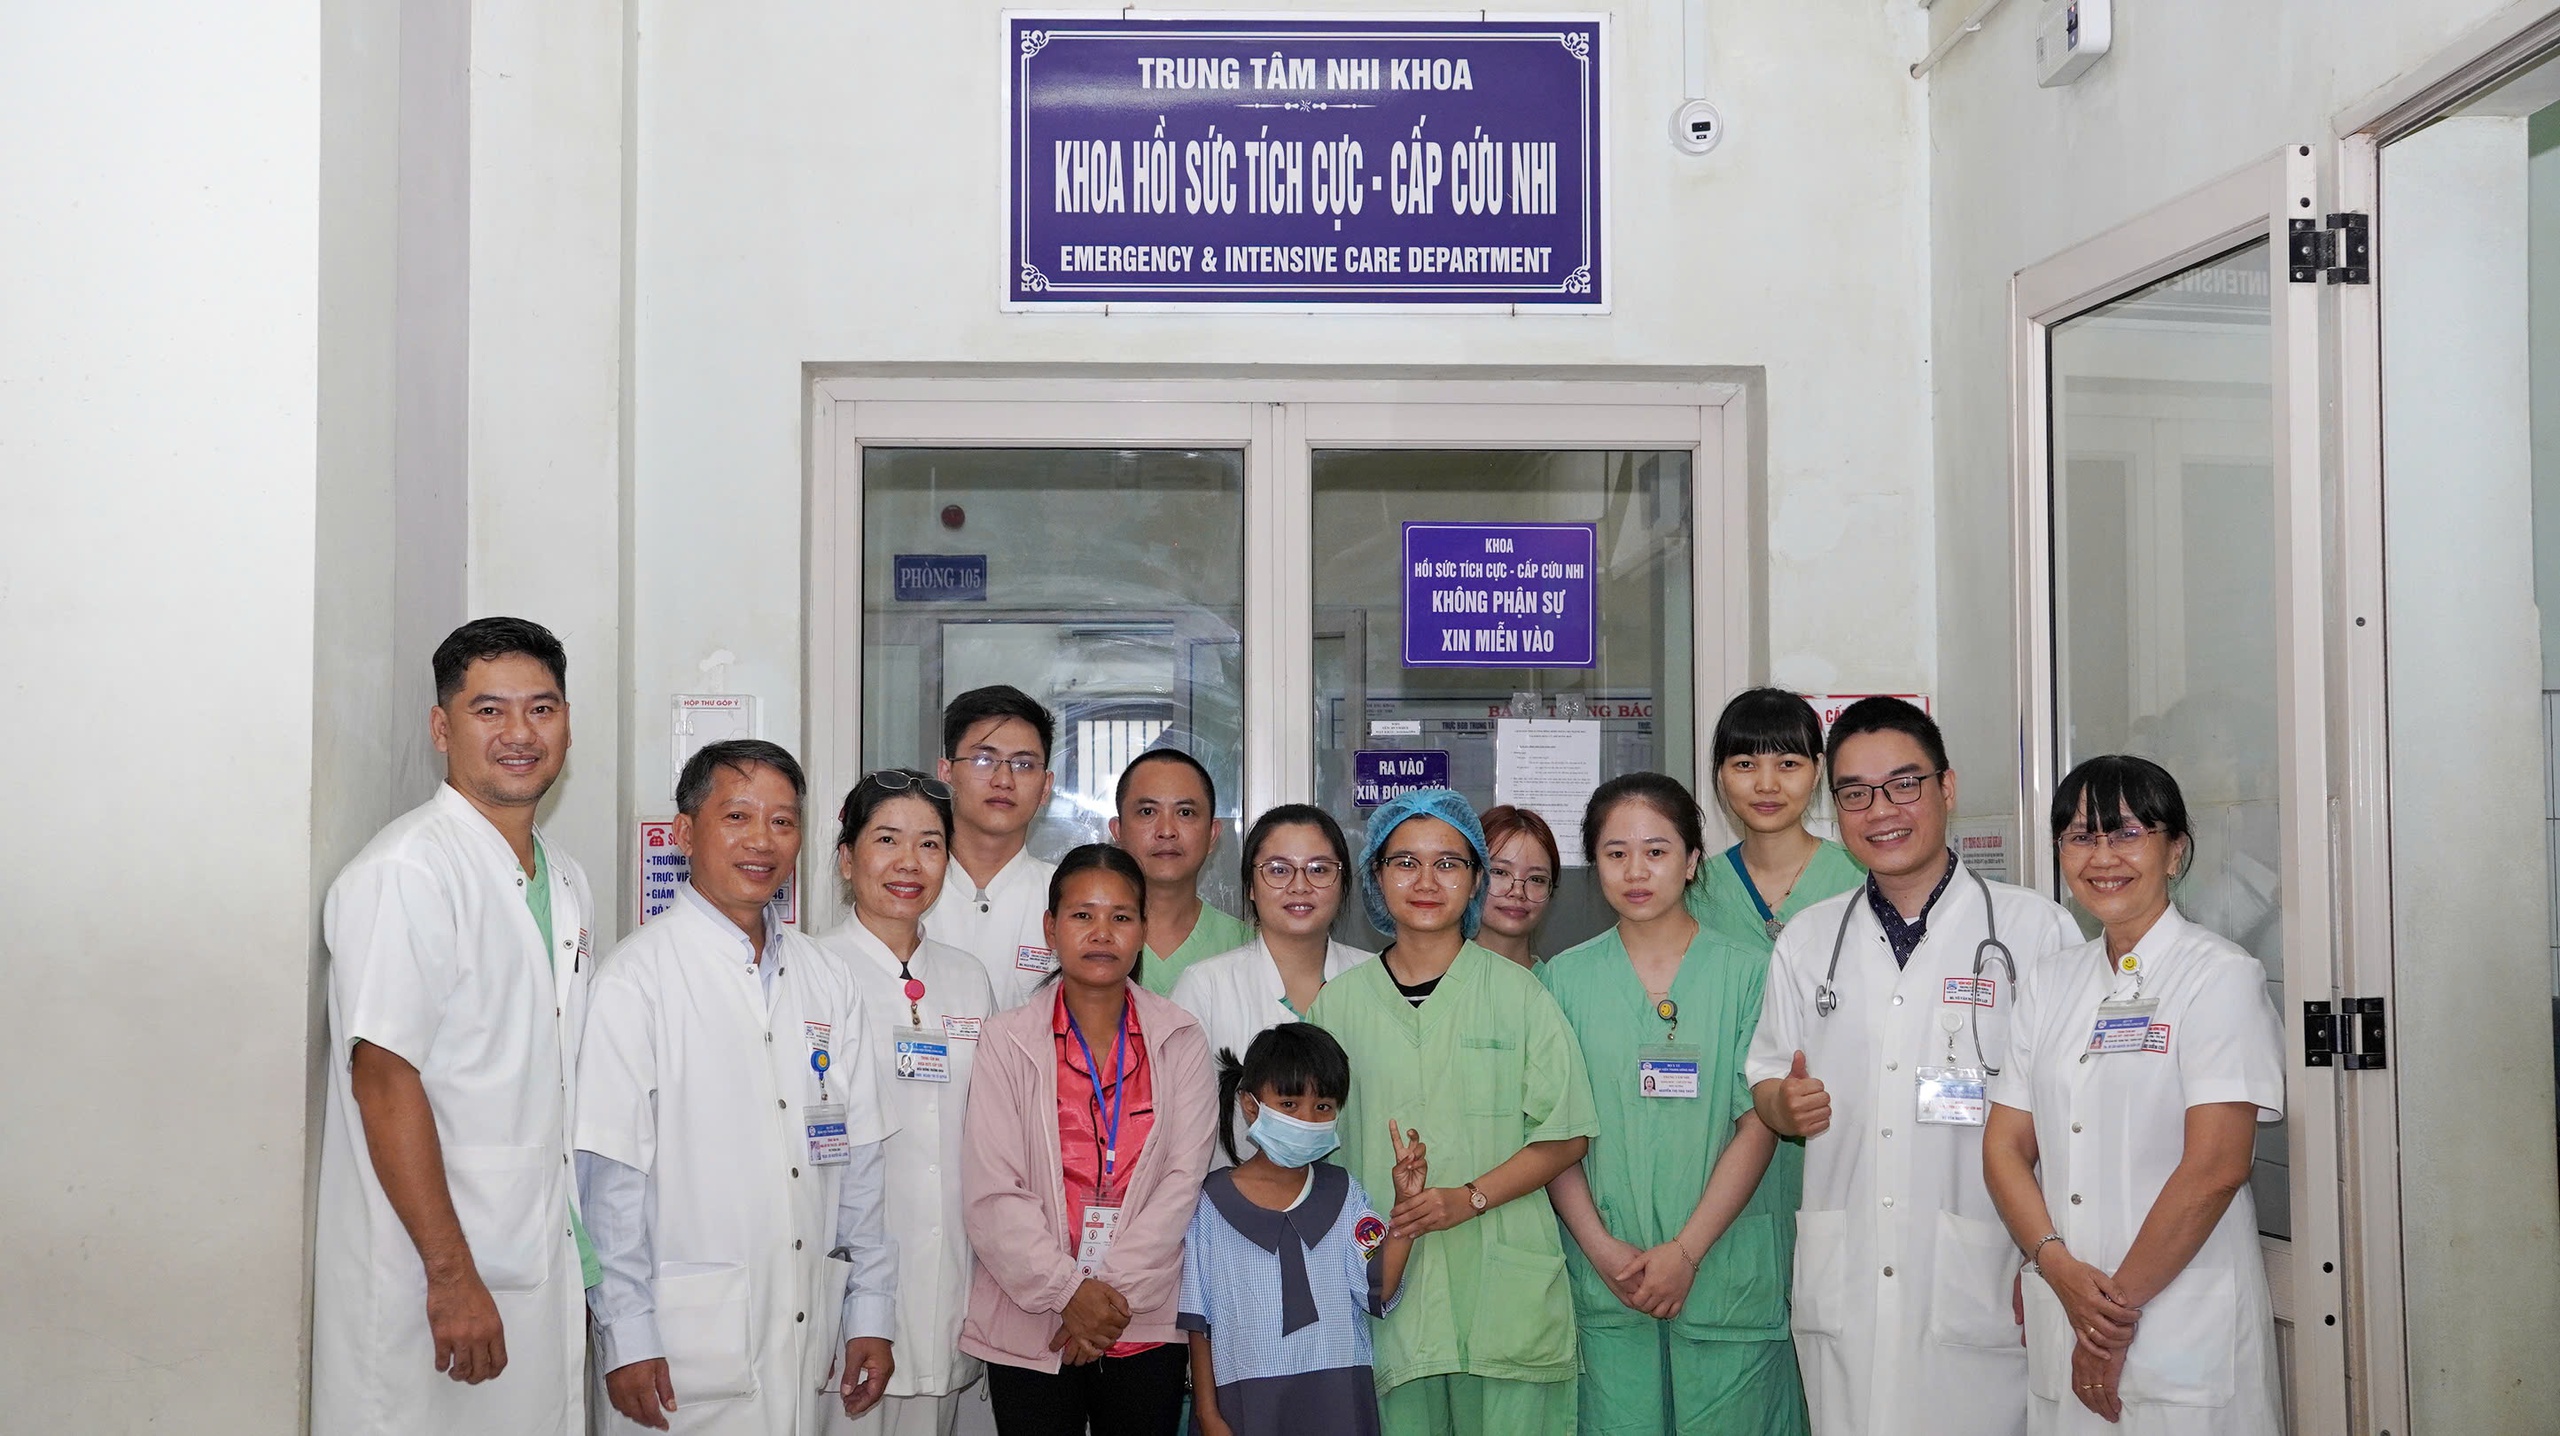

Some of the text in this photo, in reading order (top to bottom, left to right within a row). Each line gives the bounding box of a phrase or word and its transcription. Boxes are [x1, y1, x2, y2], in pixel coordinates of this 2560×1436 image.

[1138, 51, 1473, 90] TRUNG TÂM NHI KHOA
[1056, 140, 1125, 213] KHOA
[1134, 115, 1175, 214] HỒI
[1186, 125, 1236, 214] SỨC
[1245, 126, 1302, 214] TÍCH
[1312, 134, 1363, 231] CỰC
[1391, 115, 1442, 215] CẤP
[1452, 126, 1503, 215] CỨU
[1512, 142, 1556, 214] NHI
[1061, 246, 1551, 272] EMERGENCY & INTENSIVE CARE DEPARTMENT
[1486, 539, 1513, 553] KHOA
[901, 562, 981, 589] PHÒNG 105
[1415, 558, 1432, 577] HỒI
[1436, 560, 1456, 577] SỨC
[1460, 560, 1482, 577] TÍCH
[1486, 562, 1507, 581] CỰC
[1518, 559, 1538, 578] CẤP
[1542, 561, 1562, 578] CỨU
[1566, 564, 1583, 578] NHI
[1433, 586, 1566, 618] KHÔNG PHẬN SỰ
[1442, 622, 1553, 652] XIN MIỄN VÀO
[1380, 758, 1425, 775] RA VÀO
[1357, 785, 1379, 801] XIN
[652, 853, 686, 866] TRƯỞNG
[652, 872, 674, 884] TRỰC
[652, 888, 674, 899] GIÁM
